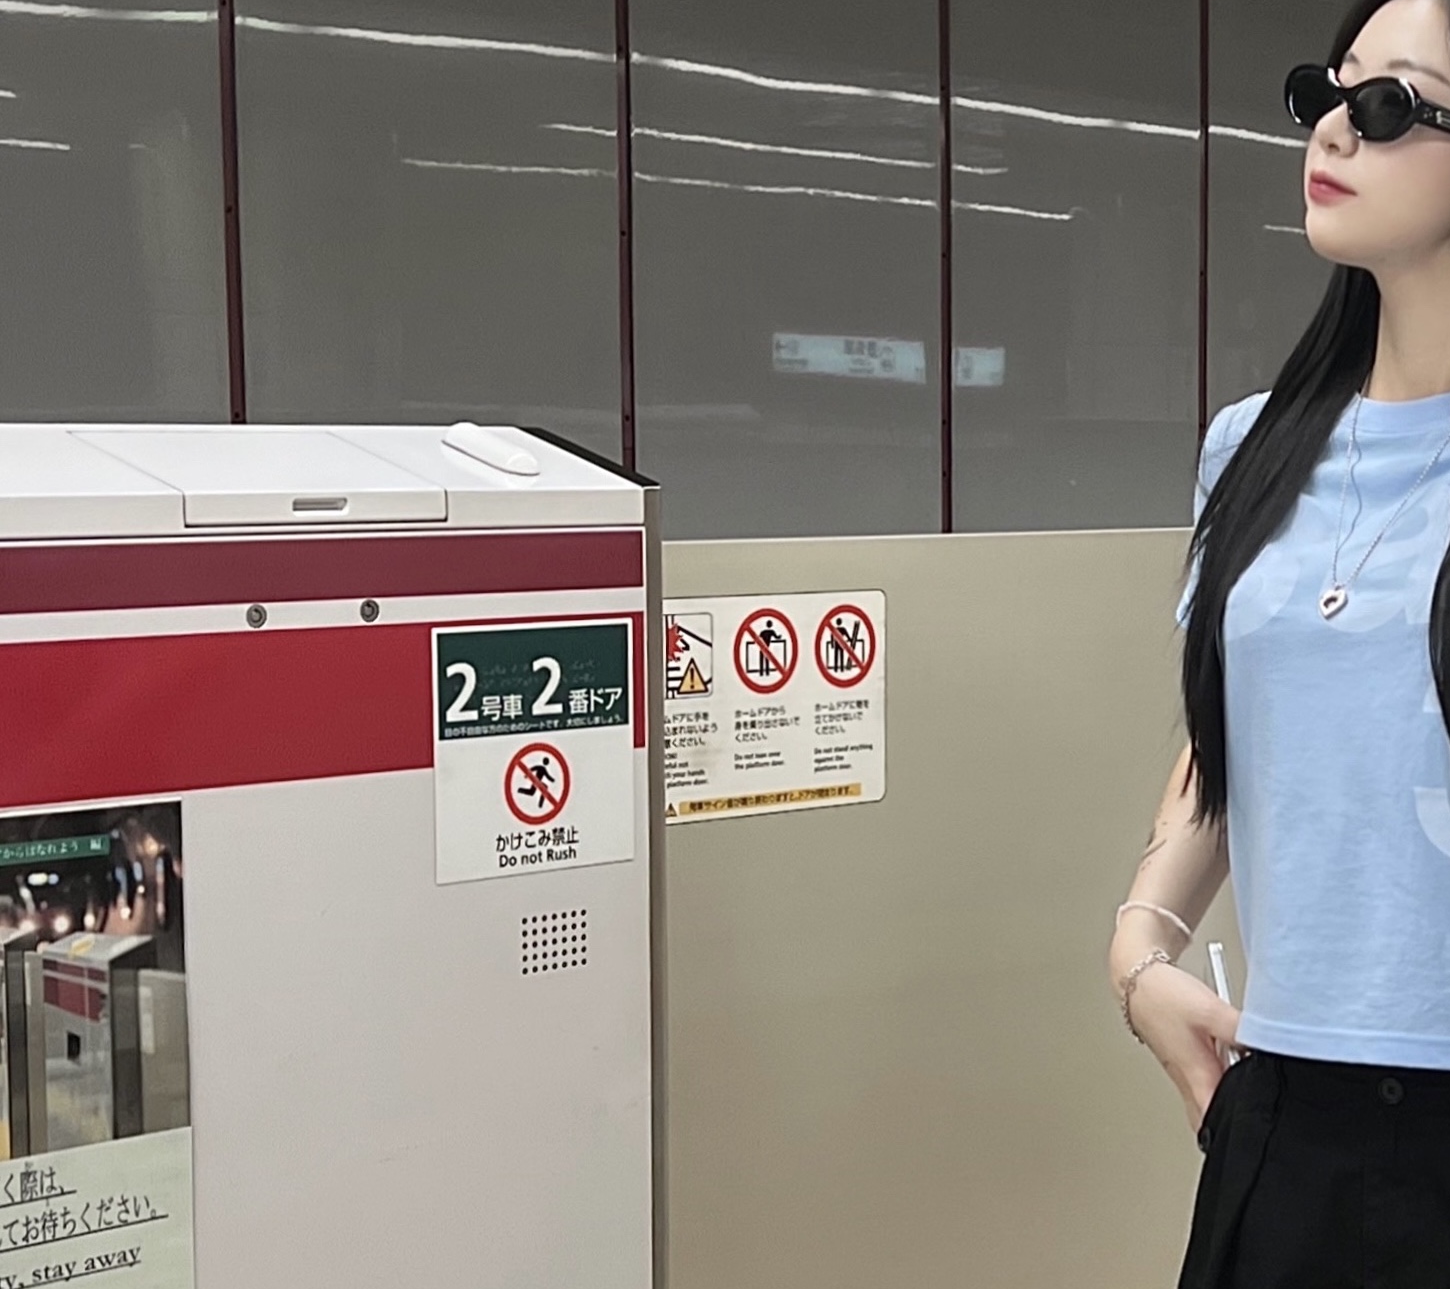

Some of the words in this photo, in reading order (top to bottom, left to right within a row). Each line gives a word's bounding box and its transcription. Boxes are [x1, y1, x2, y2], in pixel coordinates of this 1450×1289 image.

[446, 662, 523, 722] 2号車
[531, 657, 623, 717] 2番ドア
[496, 825, 579, 852] かけこみ禁止
[499, 854, 517, 868] Do
[521, 851, 542, 866] not
[546, 845, 577, 862] Rush
[0, 1195, 157, 1246] てお待ちください。
[32, 1261, 76, 1281] stay
[84, 1247, 141, 1267] away
